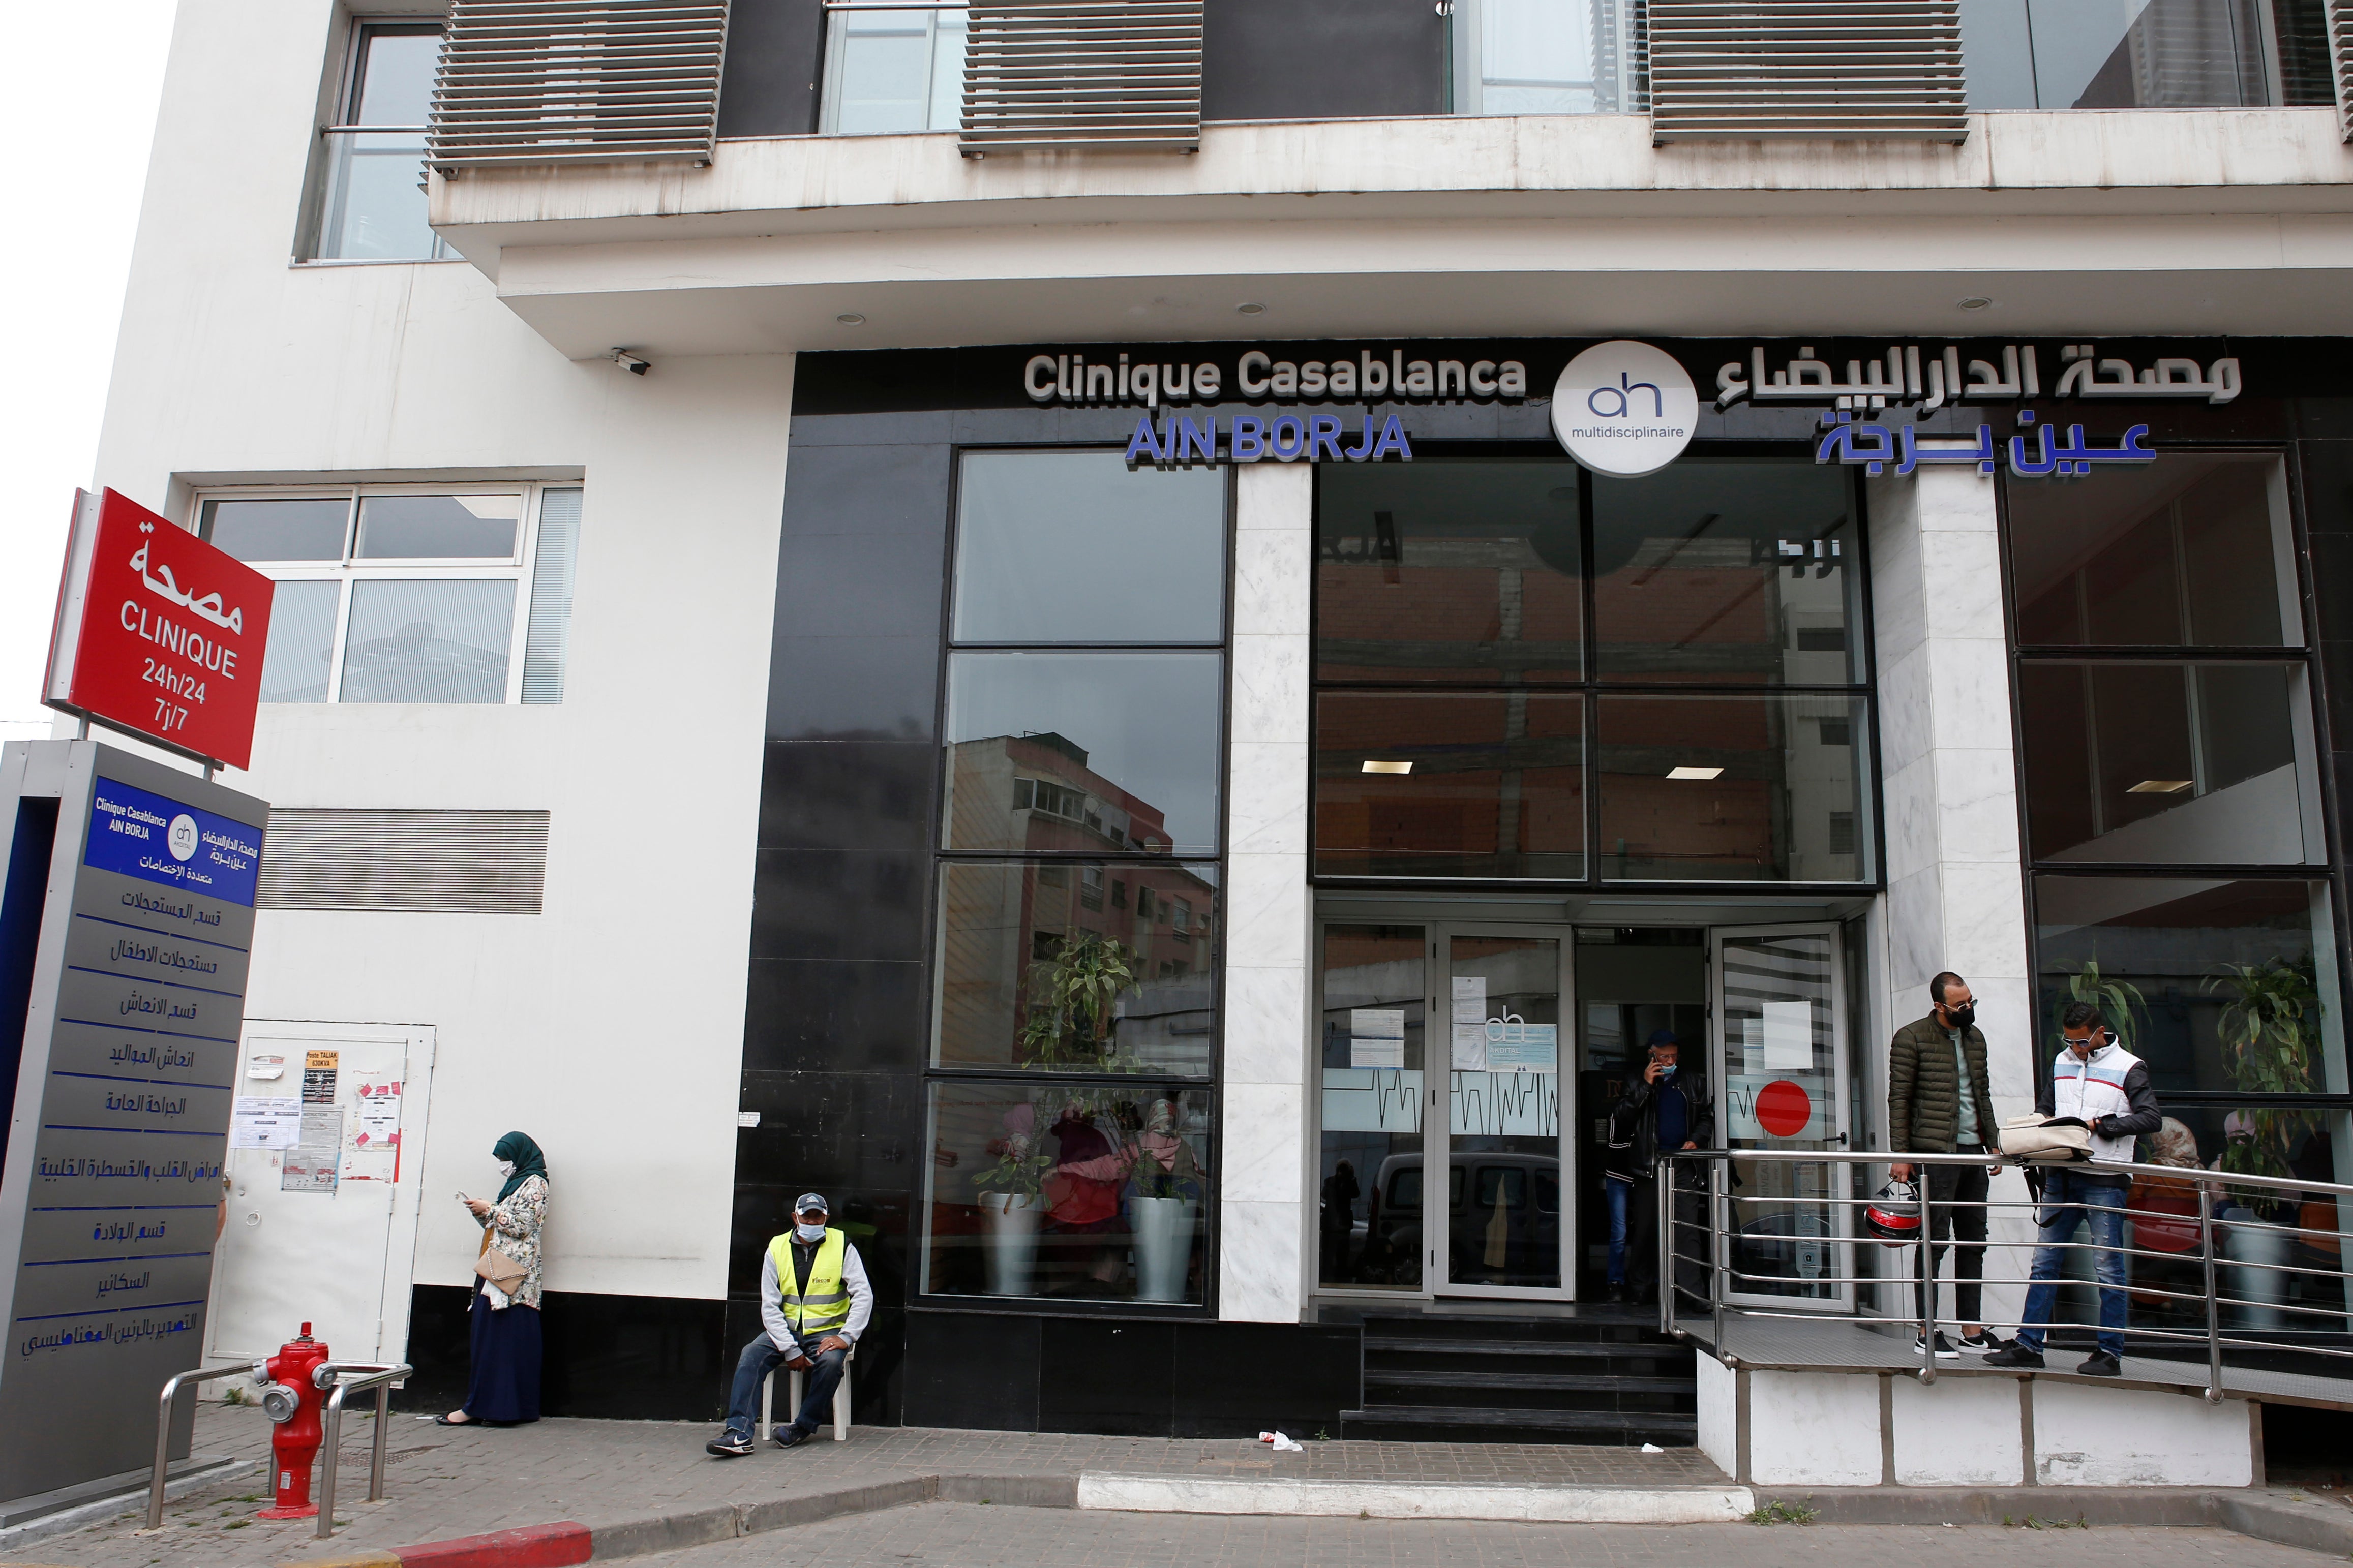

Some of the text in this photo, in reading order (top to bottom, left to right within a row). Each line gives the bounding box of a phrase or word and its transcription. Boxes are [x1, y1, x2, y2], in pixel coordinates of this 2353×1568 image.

[1025, 350, 1525, 411] Clinique Casablanca
[2055, 345, 2242, 404] مصحة
[1125, 414, 1412, 464] AIN BORJA
[1572, 426, 1684, 440] multidisciplinaire
[2008, 410, 2156, 477] عين
[129, 521, 243, 636] مصحة
[120, 600, 238, 680] CLINIQUE
[142, 657, 206, 705] 24h/24
[155, 697, 188, 731] 7j/7
[96, 797, 166, 827] Clinique Casablanca
[109, 819, 149, 840] AIN BORJA
[187, 866, 213, 885] متعددة
[122, 893, 221, 926] قسم المستعجلات
[110, 939, 217, 974] مستعجلات الاطفال
[120, 990, 197, 1019] قسم الانعاش
[109, 1044, 156, 1066] المواليد
[106, 1092, 186, 1119] الجراحة العامة
[38, 1157, 221, 1183] امراض القلب والقسطرة القلبية
[94, 1221, 165, 1243] قسم الولادة
[96, 1271, 150, 1299] السكانير
[22, 1313, 197, 1362] التصوير بالرنين المغناطيسي
